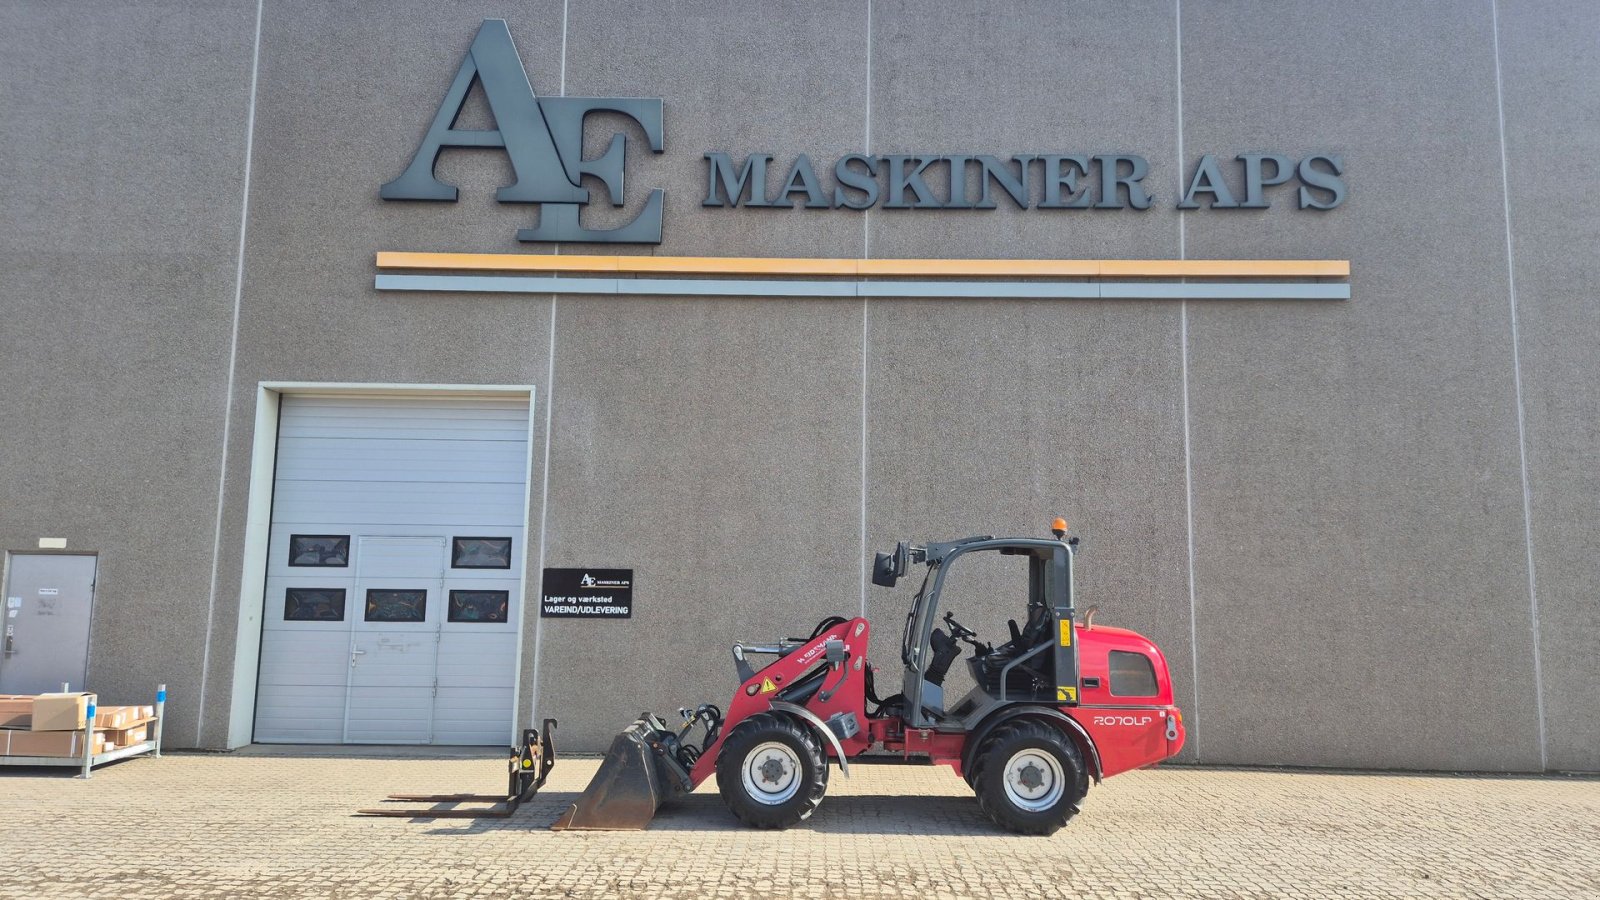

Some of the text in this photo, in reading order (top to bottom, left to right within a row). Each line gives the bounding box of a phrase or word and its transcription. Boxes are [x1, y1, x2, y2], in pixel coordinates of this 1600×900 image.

[380, 18, 1345, 244] AE MASKINER APS
[580, 573, 596, 586] AE
[544, 595, 566, 604] Lager
[567, 596, 577, 604] og
[544, 605, 629, 614] VAREIND/UDLEVERING
